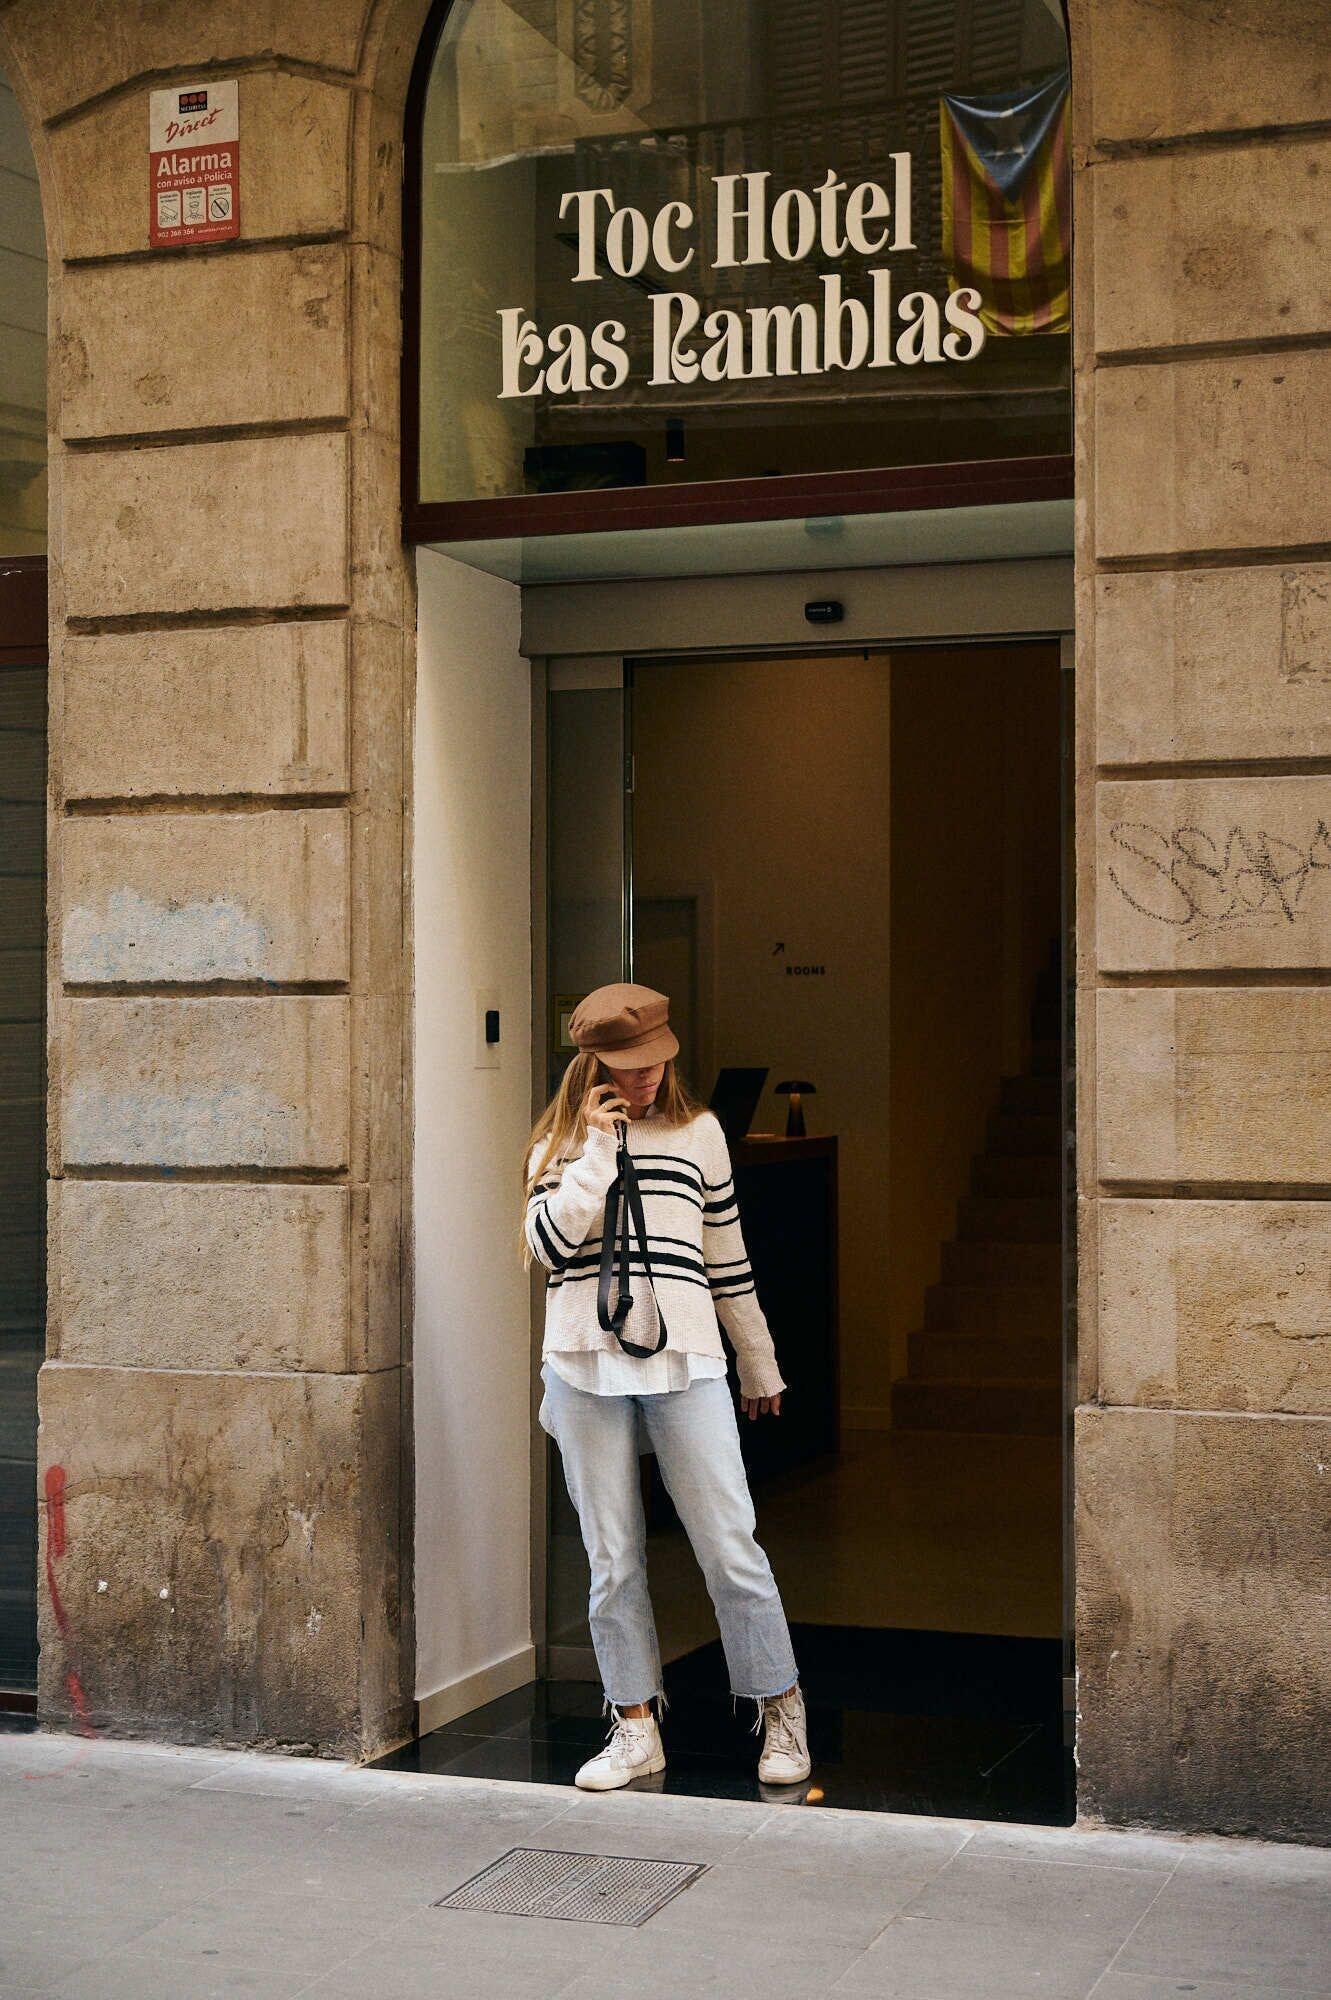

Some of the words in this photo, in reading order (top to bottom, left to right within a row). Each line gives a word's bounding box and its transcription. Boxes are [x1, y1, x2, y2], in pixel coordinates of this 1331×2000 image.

[165, 108, 224, 143] Direct
[157, 152, 232, 177] Alarma
[157, 179, 172, 189] con
[173, 175, 195, 187] aviso
[197, 176, 203, 184] a
[559, 189, 695, 283] Toc
[711, 152, 917, 268] Hotel
[496, 307, 629, 399] Las
[648, 269, 986, 386] Ramblas
[786, 966, 825, 976] ROOMS
